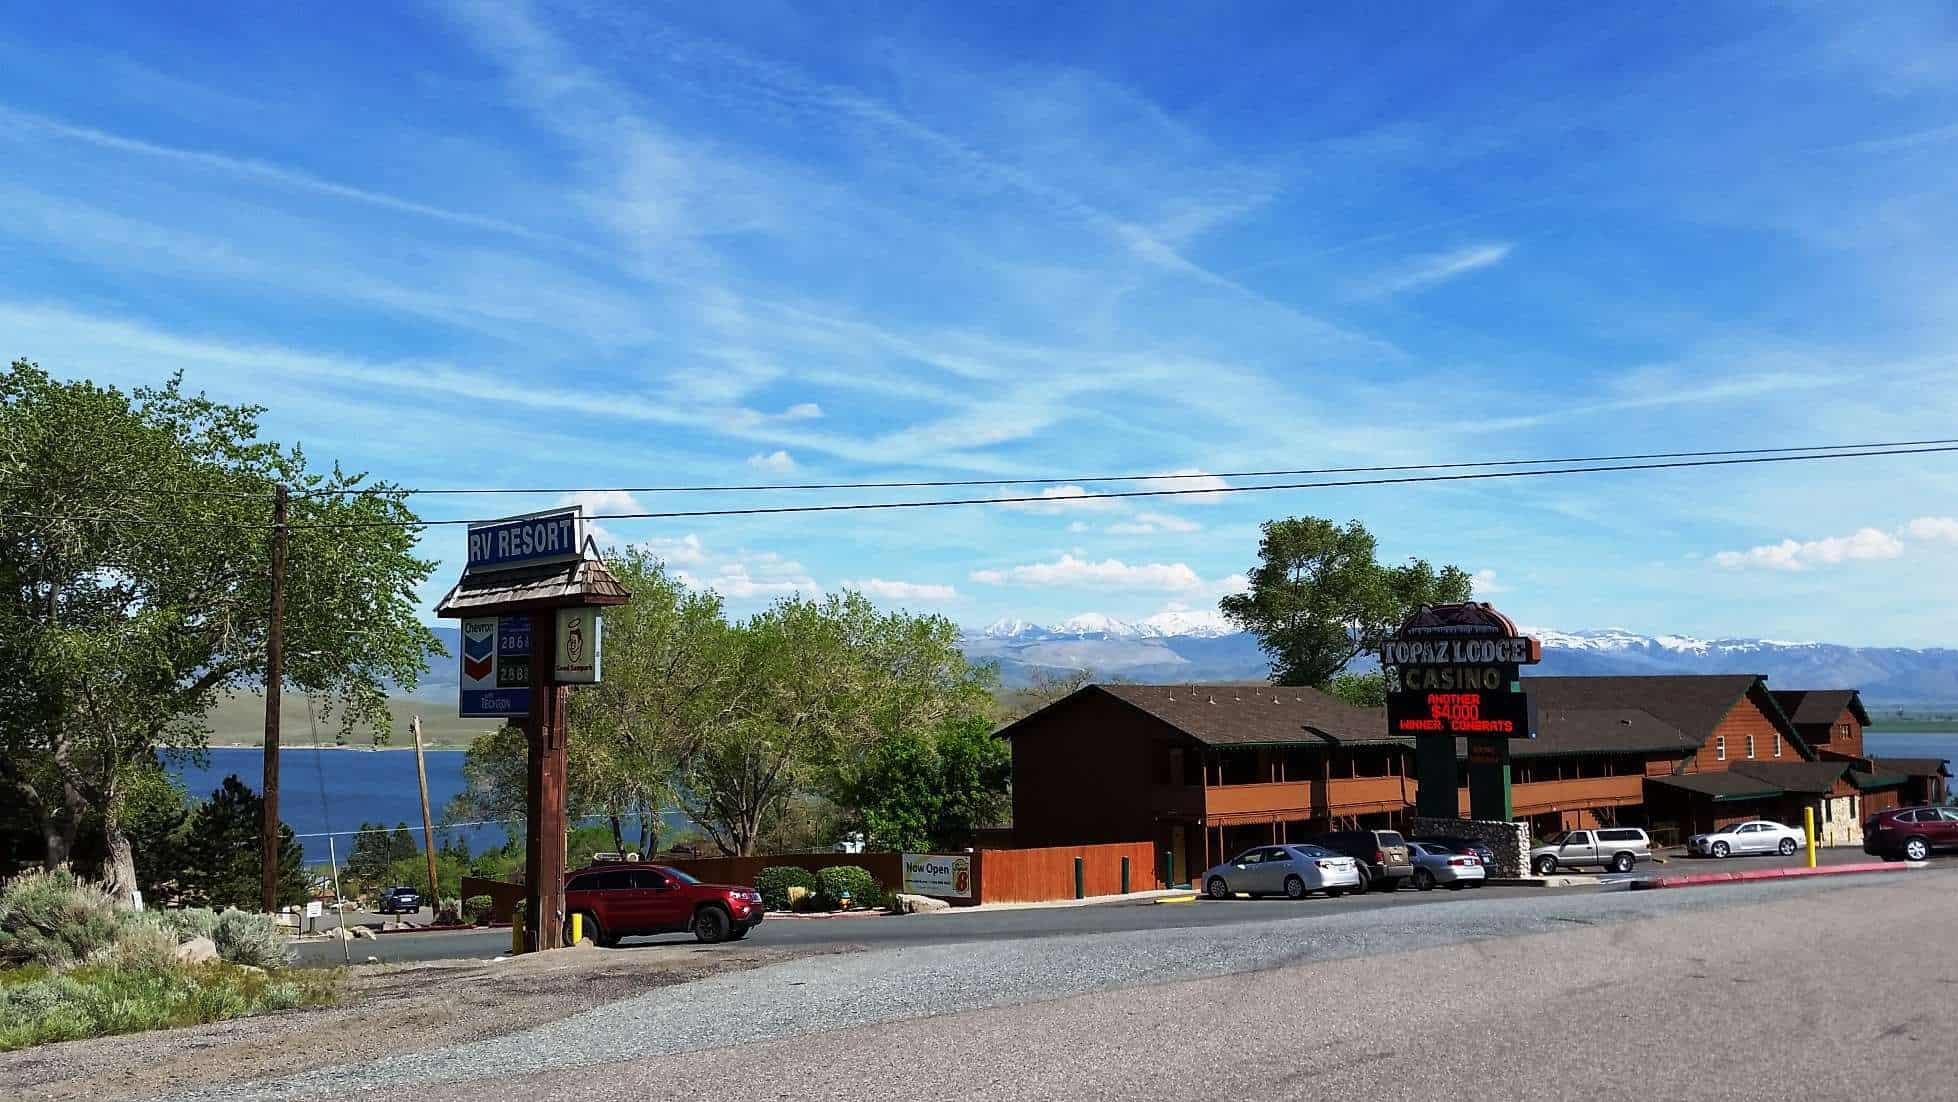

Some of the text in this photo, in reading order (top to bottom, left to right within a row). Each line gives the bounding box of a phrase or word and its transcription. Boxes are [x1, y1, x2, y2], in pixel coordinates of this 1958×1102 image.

[469, 519, 572, 561] RV RESORT
[465, 622, 494, 634] Chevron
[1385, 639, 1527, 664] TOPAZ LODGE
[1405, 667, 1500, 690] CASINO
[1428, 694, 1481, 705] ANOTHER
[1451, 720, 1513, 732] CONGRATS
[906, 861, 925, 873] Now
[926, 863, 949, 876] Open
